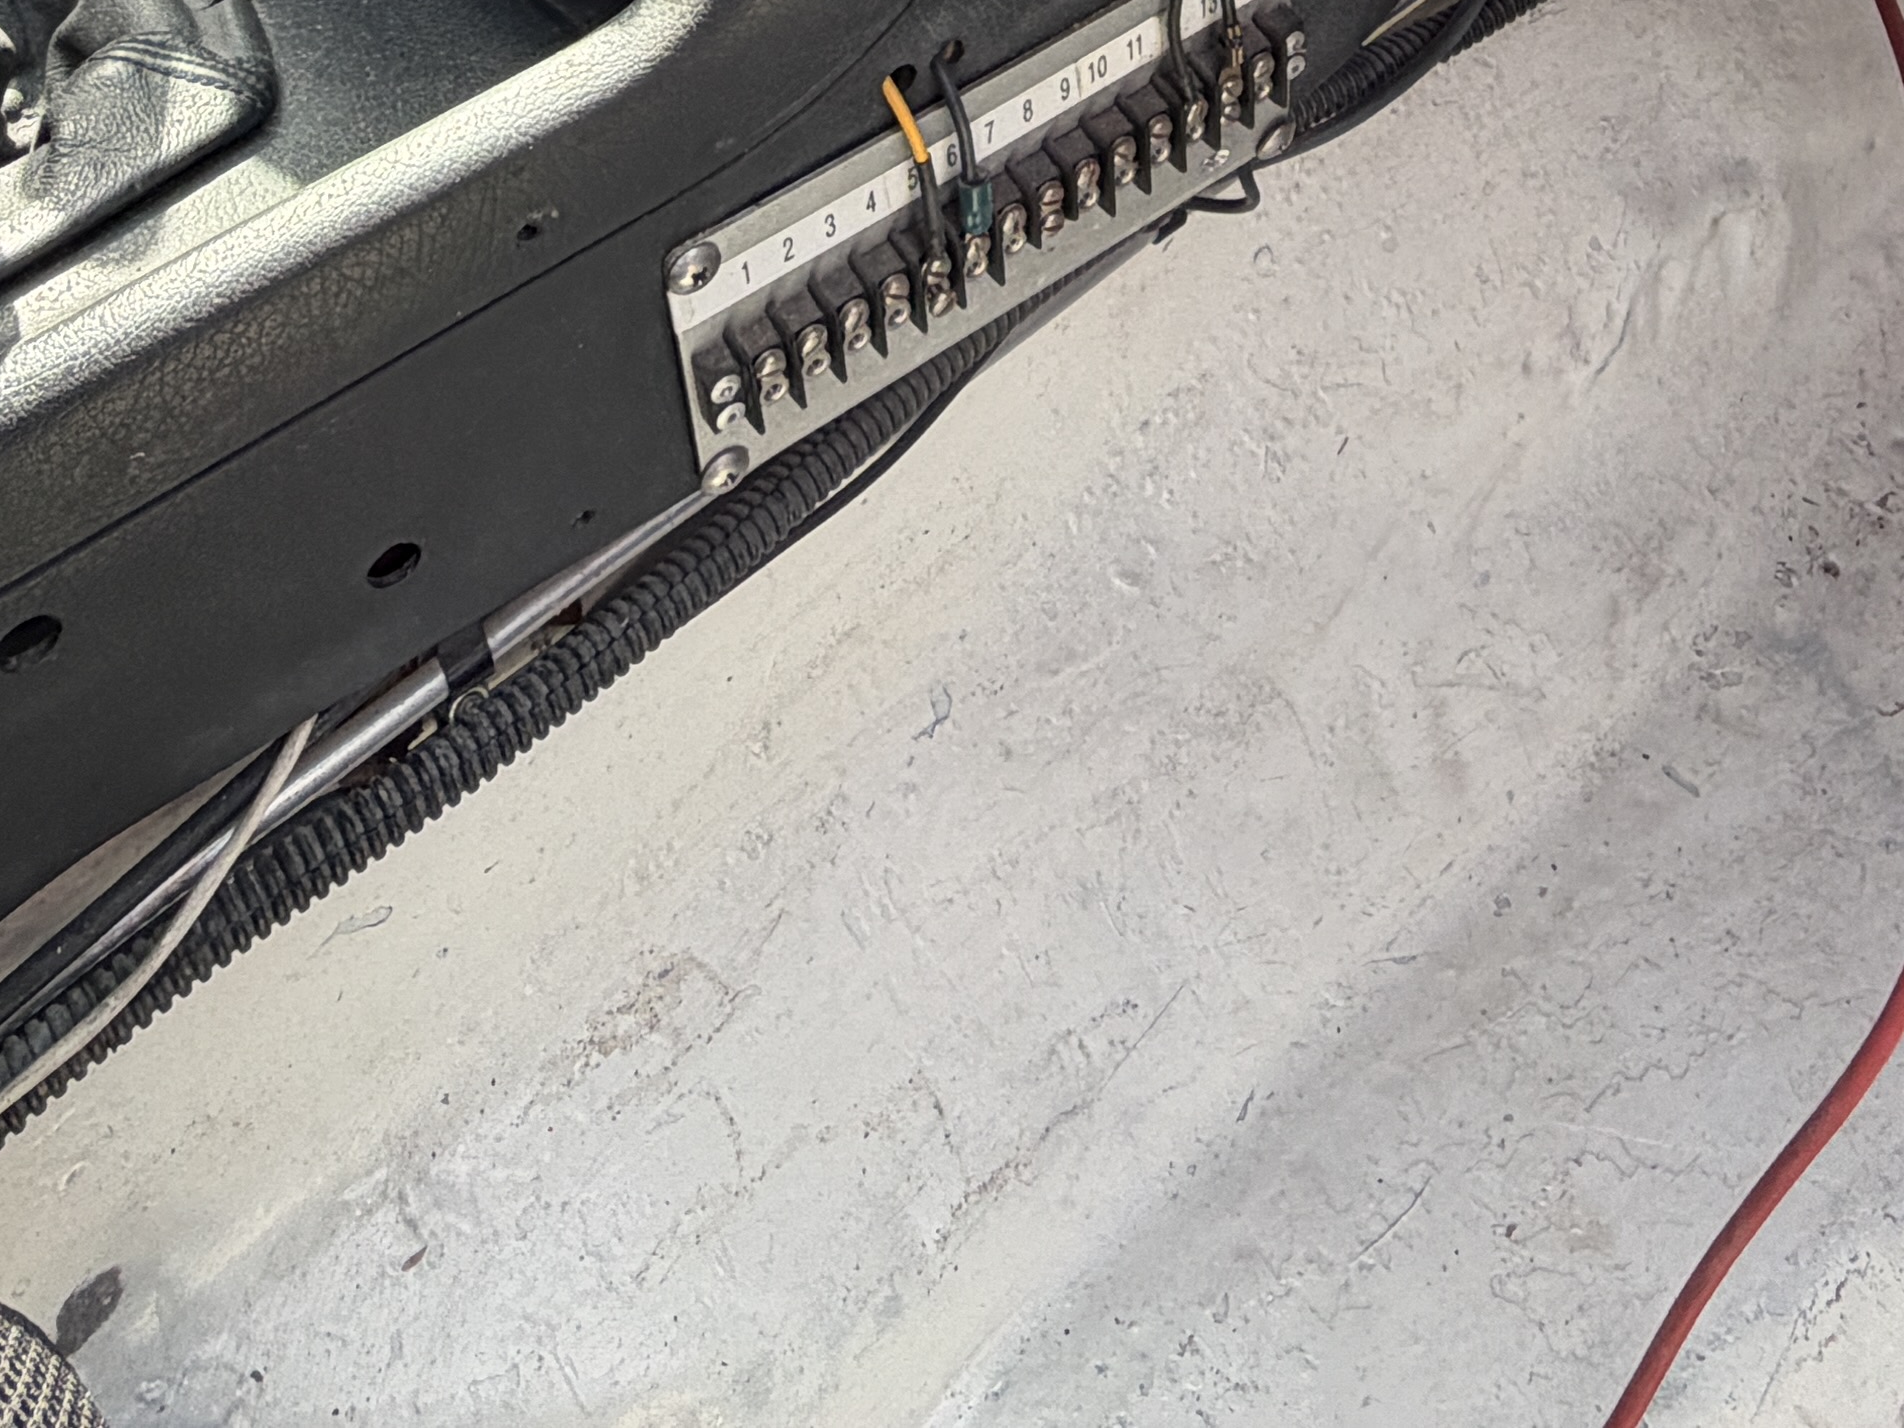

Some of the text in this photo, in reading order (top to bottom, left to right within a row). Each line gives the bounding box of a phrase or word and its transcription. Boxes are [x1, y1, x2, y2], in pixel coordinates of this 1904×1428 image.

[741, 260, 751, 285] 1
[782, 236, 796, 262] 2
[824, 213, 837, 238] 3
[865, 190, 877, 213] 4
[907, 166, 919, 191] 5
[946, 143, 959, 168] 6
[983, 119, 995, 145] 7
[1022, 98, 1034, 123] 8
[1059, 76, 1072, 101] 9
[1087, 55, 1108, 83] 10
[1126, 33, 1143, 61] 11
